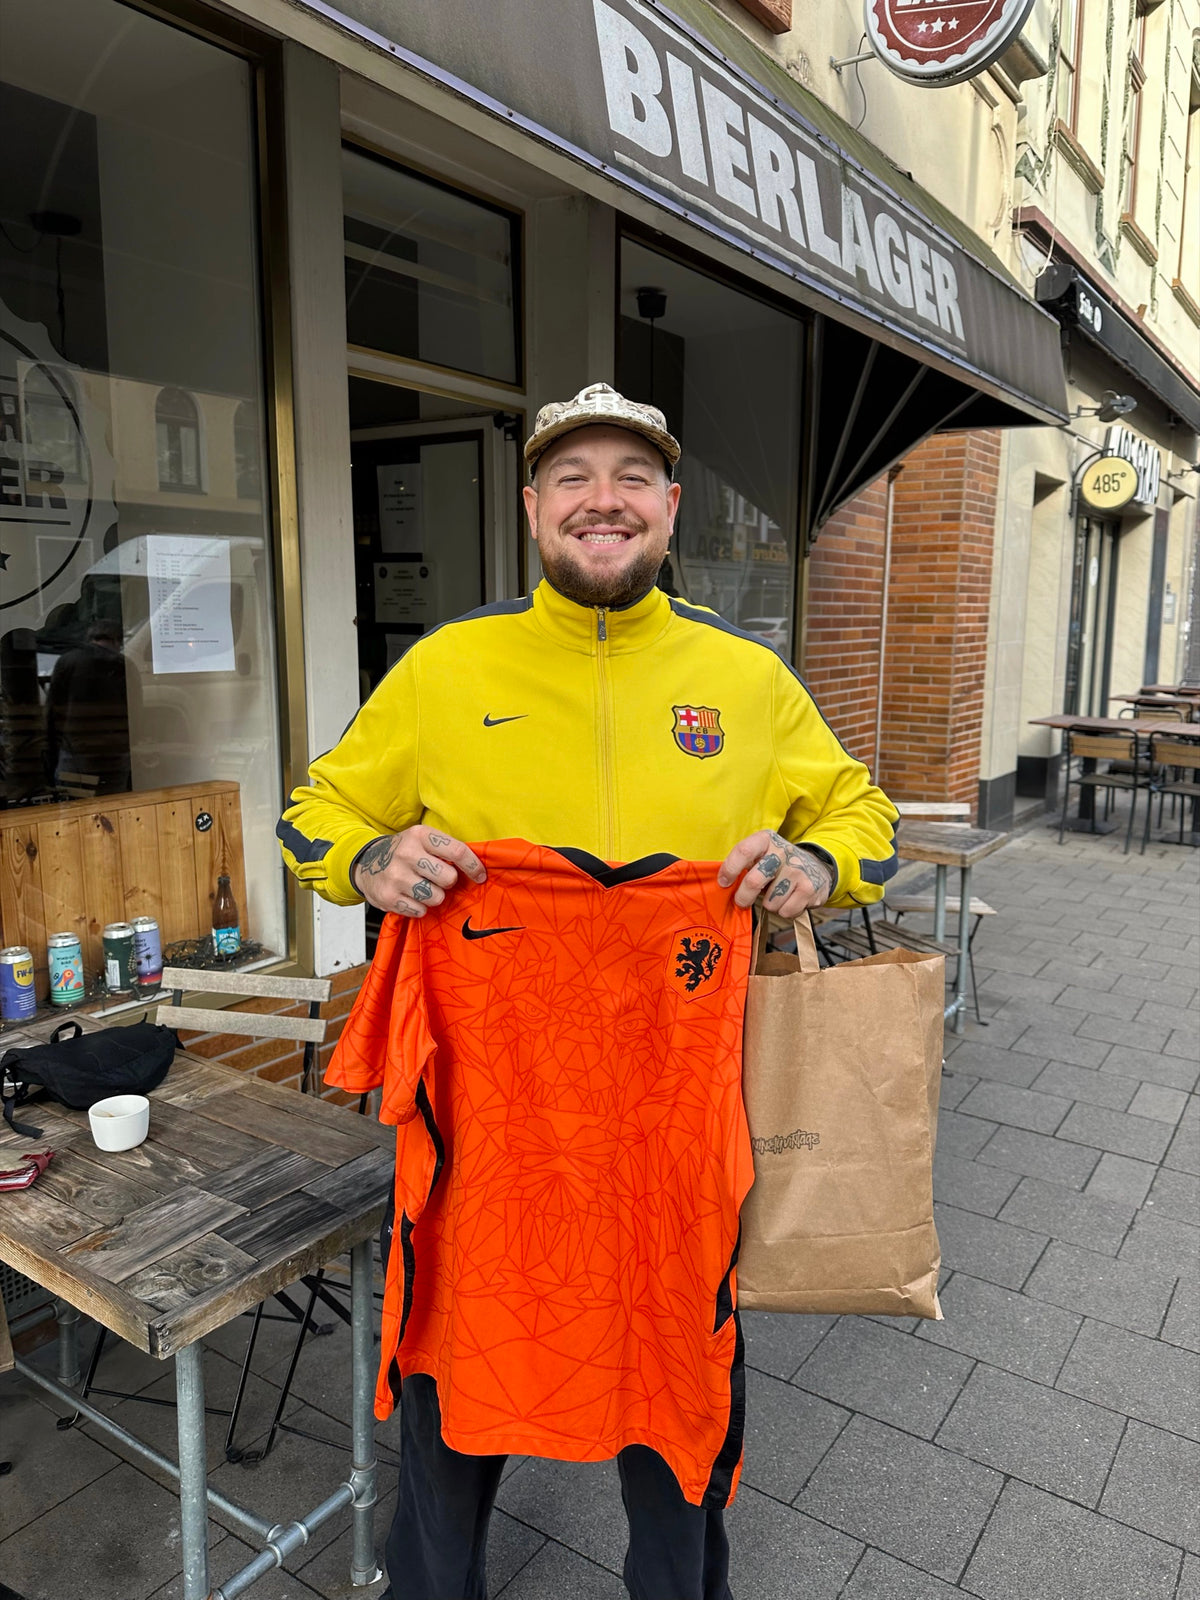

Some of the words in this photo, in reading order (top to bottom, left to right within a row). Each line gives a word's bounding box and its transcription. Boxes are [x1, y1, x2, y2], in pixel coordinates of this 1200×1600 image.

[592, 0, 966, 342] BIERLAGER
[1091, 471, 1127, 494] 485°
[689, 726, 709, 735] FCB
